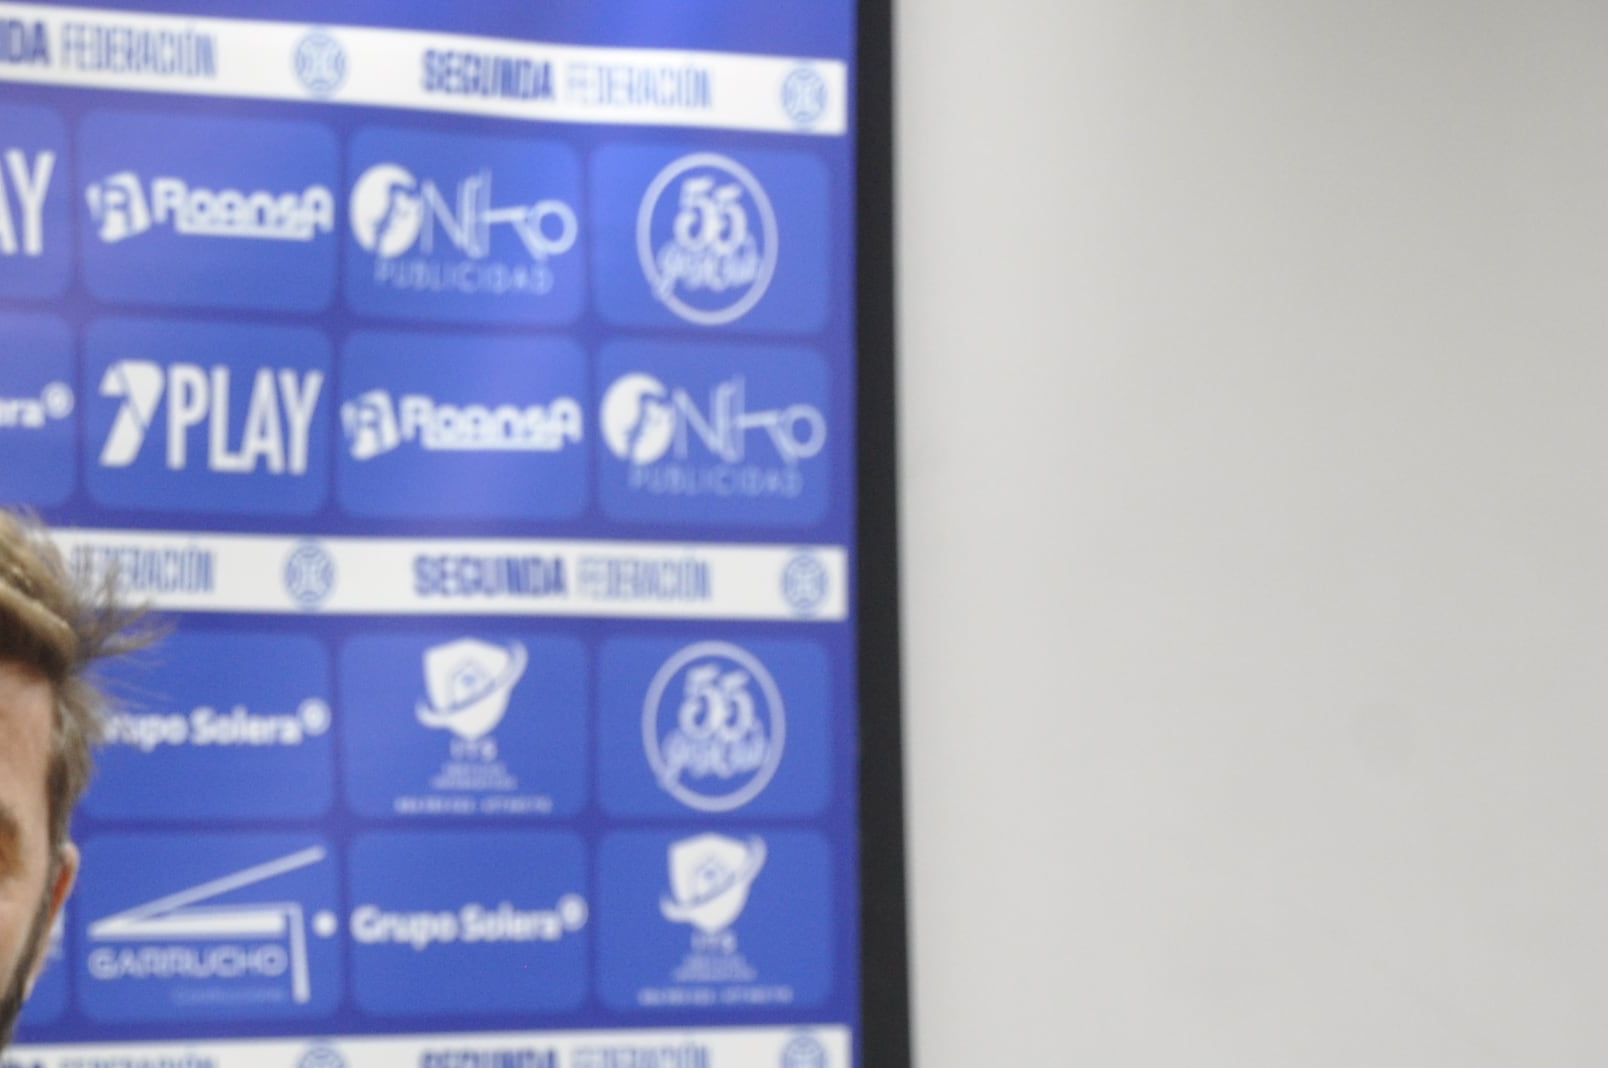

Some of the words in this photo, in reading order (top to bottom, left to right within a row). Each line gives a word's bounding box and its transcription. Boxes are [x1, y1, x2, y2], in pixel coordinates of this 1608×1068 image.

[421, 48, 554, 101] SEGUNDA
[412, 554, 567, 598] SEGUNDA
[350, 904, 457, 951] Grupo
[88, 946, 288, 980] GARRUCHO
